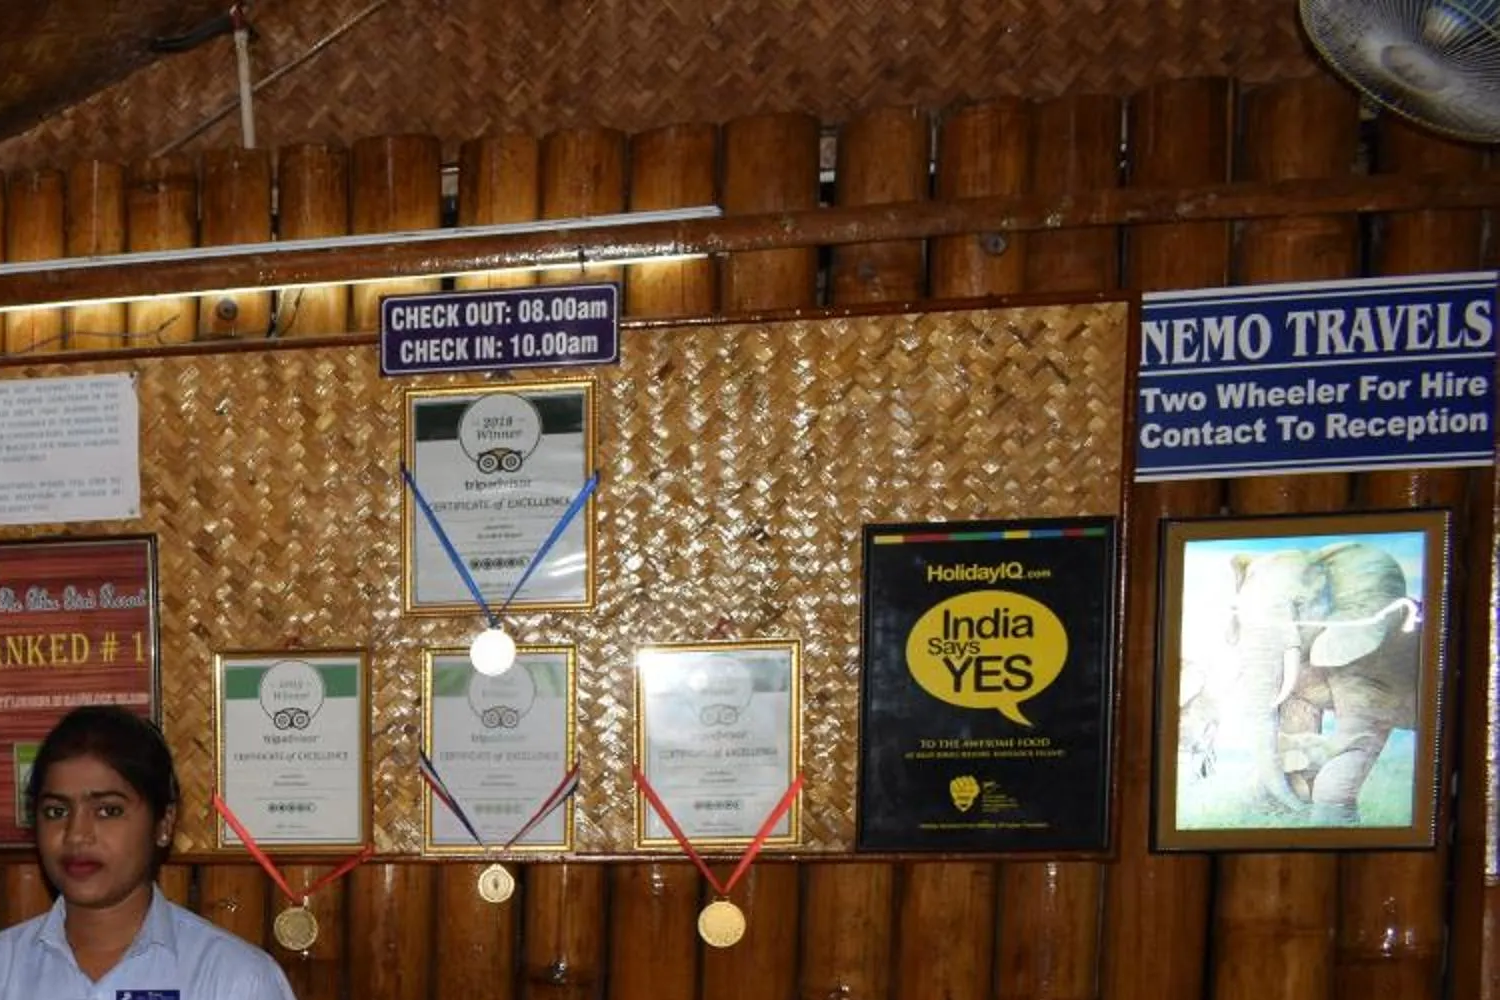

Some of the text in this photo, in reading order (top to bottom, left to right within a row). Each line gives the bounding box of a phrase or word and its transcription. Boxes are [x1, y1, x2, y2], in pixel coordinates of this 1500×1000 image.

[391, 297, 608, 330] CHECK OUT: 08.00am
[400, 331, 599, 363] CHECK IN: 10.00am
[1141, 299, 1493, 366] NEMO TRAVELS
[1141, 371, 1488, 414] Two Wheeler For Hire
[1141, 407, 1488, 449] Contact To Reception
[943, 608, 1034, 640] India
[100, 632, 119, 662] #
[131, 631, 146, 664] 1
[927, 638, 980, 658] Says
[941, 654, 1034, 693] YES
